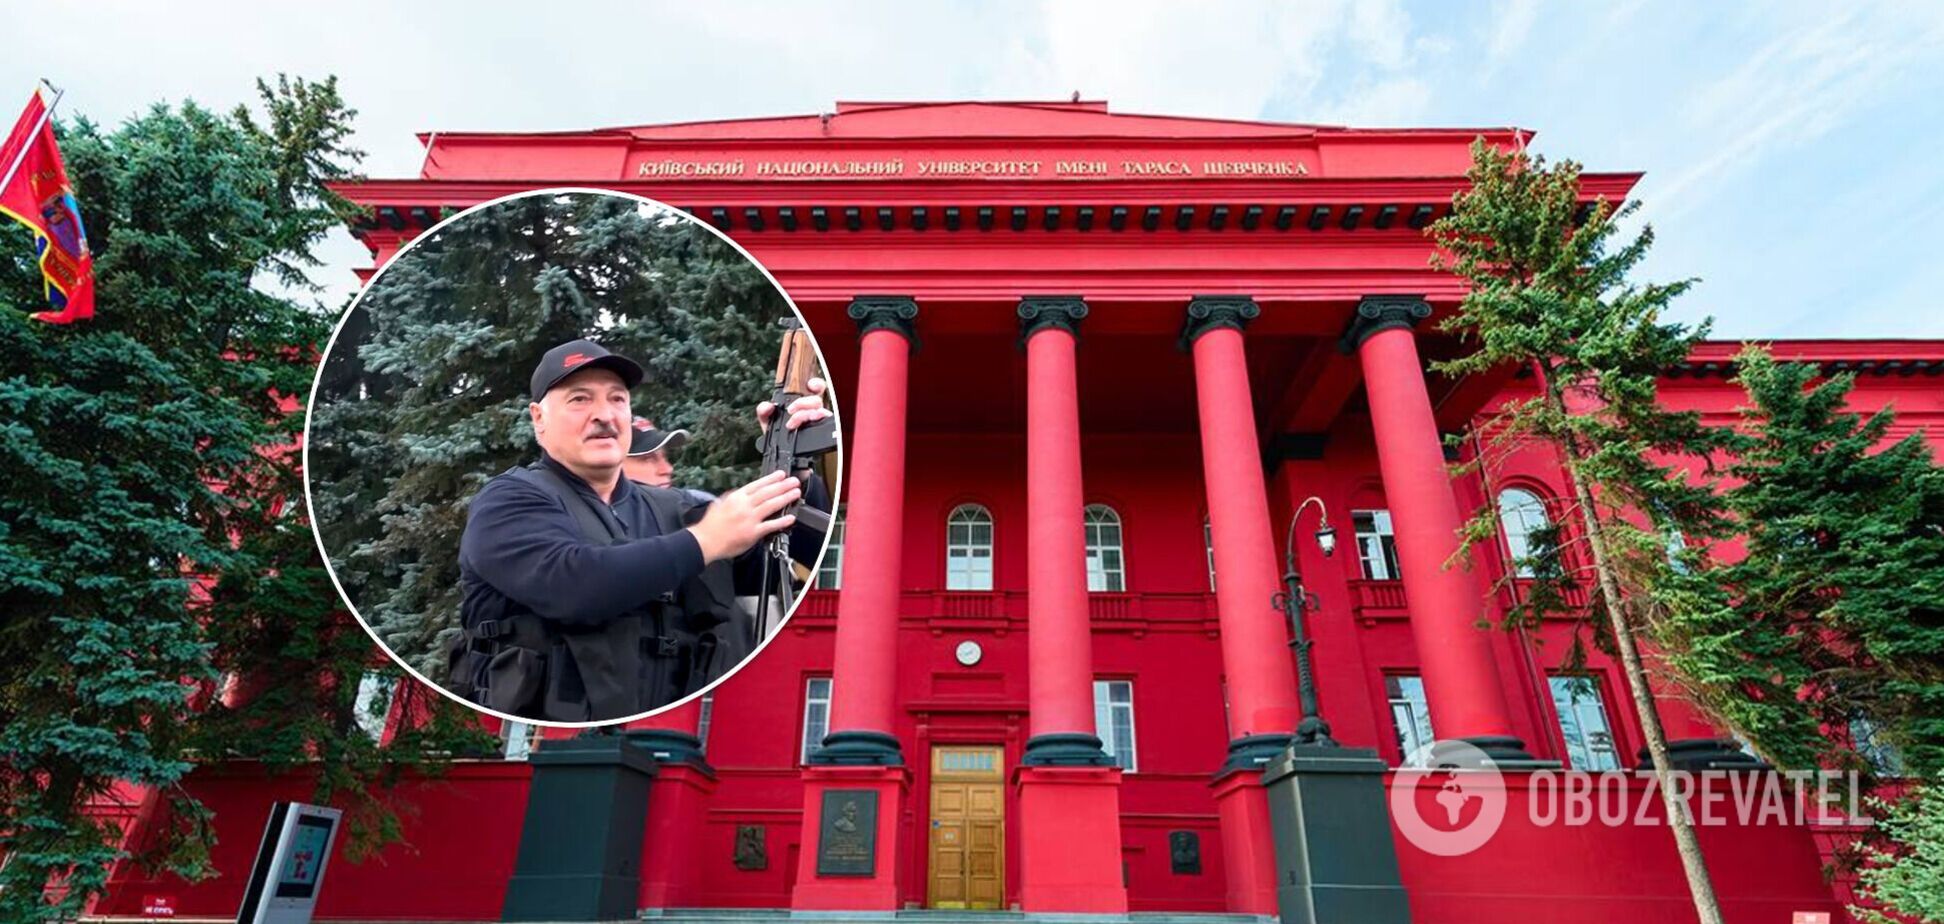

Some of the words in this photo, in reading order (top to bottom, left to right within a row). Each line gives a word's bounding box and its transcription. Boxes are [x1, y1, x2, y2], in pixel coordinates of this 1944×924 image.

[639, 159, 745, 176] КИЇВСЬКИЙ
[756, 159, 904, 176] НАЦІОНАЛЬНИЙ
[918, 161, 1042, 175] УНІВЕРСИТЕТ
[1056, 161, 1107, 175] ІМЕНІ
[1120, 161, 1192, 175] ТАРАСА
[1203, 162, 1309, 176] ШЕВЧЕНКА
